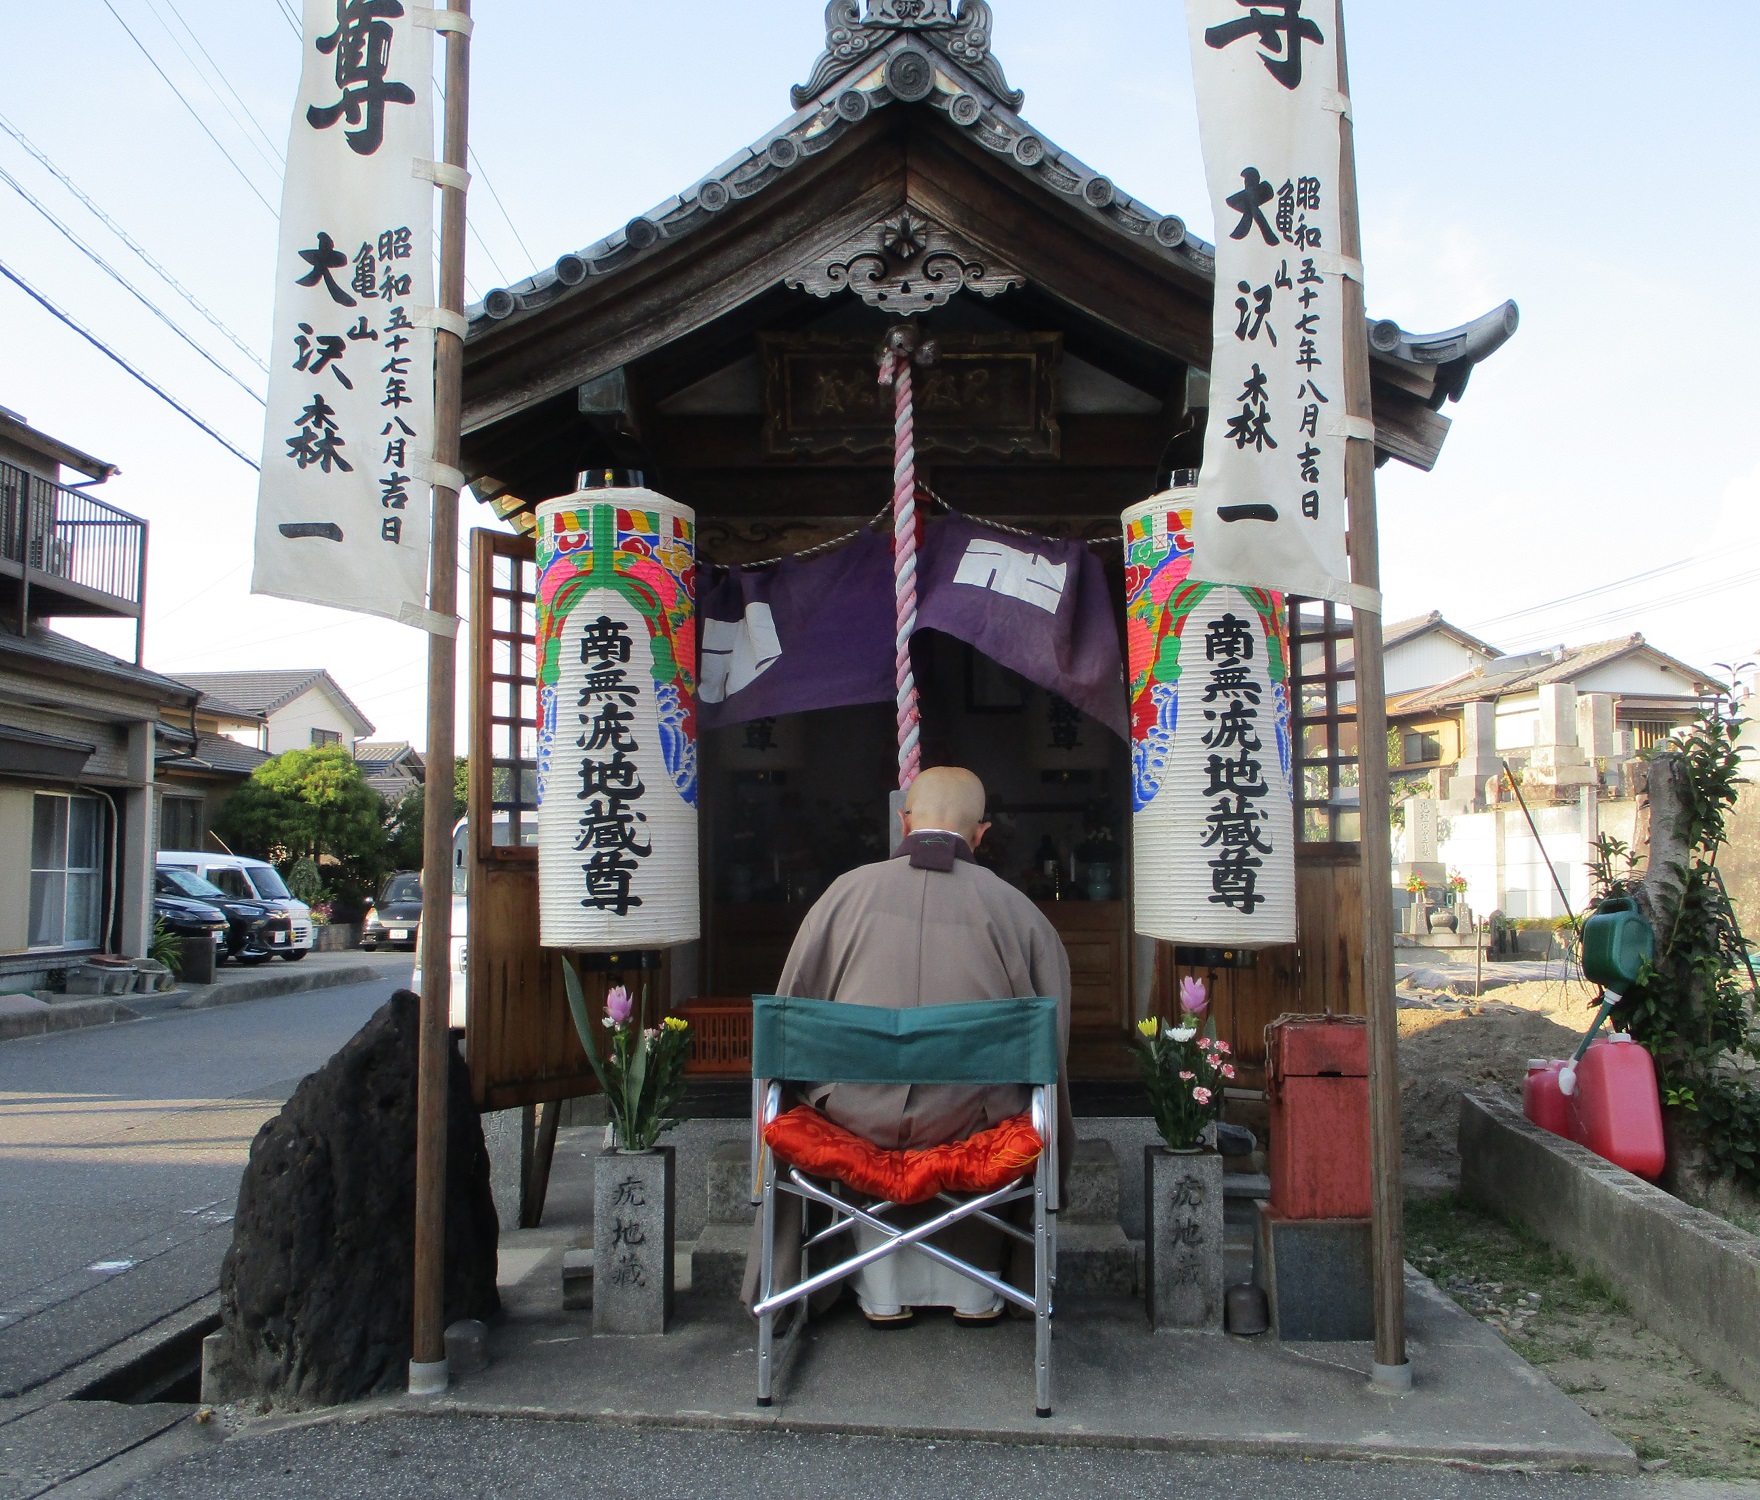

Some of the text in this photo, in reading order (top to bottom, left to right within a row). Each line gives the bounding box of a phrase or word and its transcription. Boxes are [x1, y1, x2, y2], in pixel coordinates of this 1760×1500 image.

[279, 231, 357, 544] 大沢森一
[378, 226, 417, 546] 昭和五十七年八月吉日
[1216, 166, 1281, 523] 大沢森一
[1294, 175, 1329, 521] 昭和五十七年八月吉日
